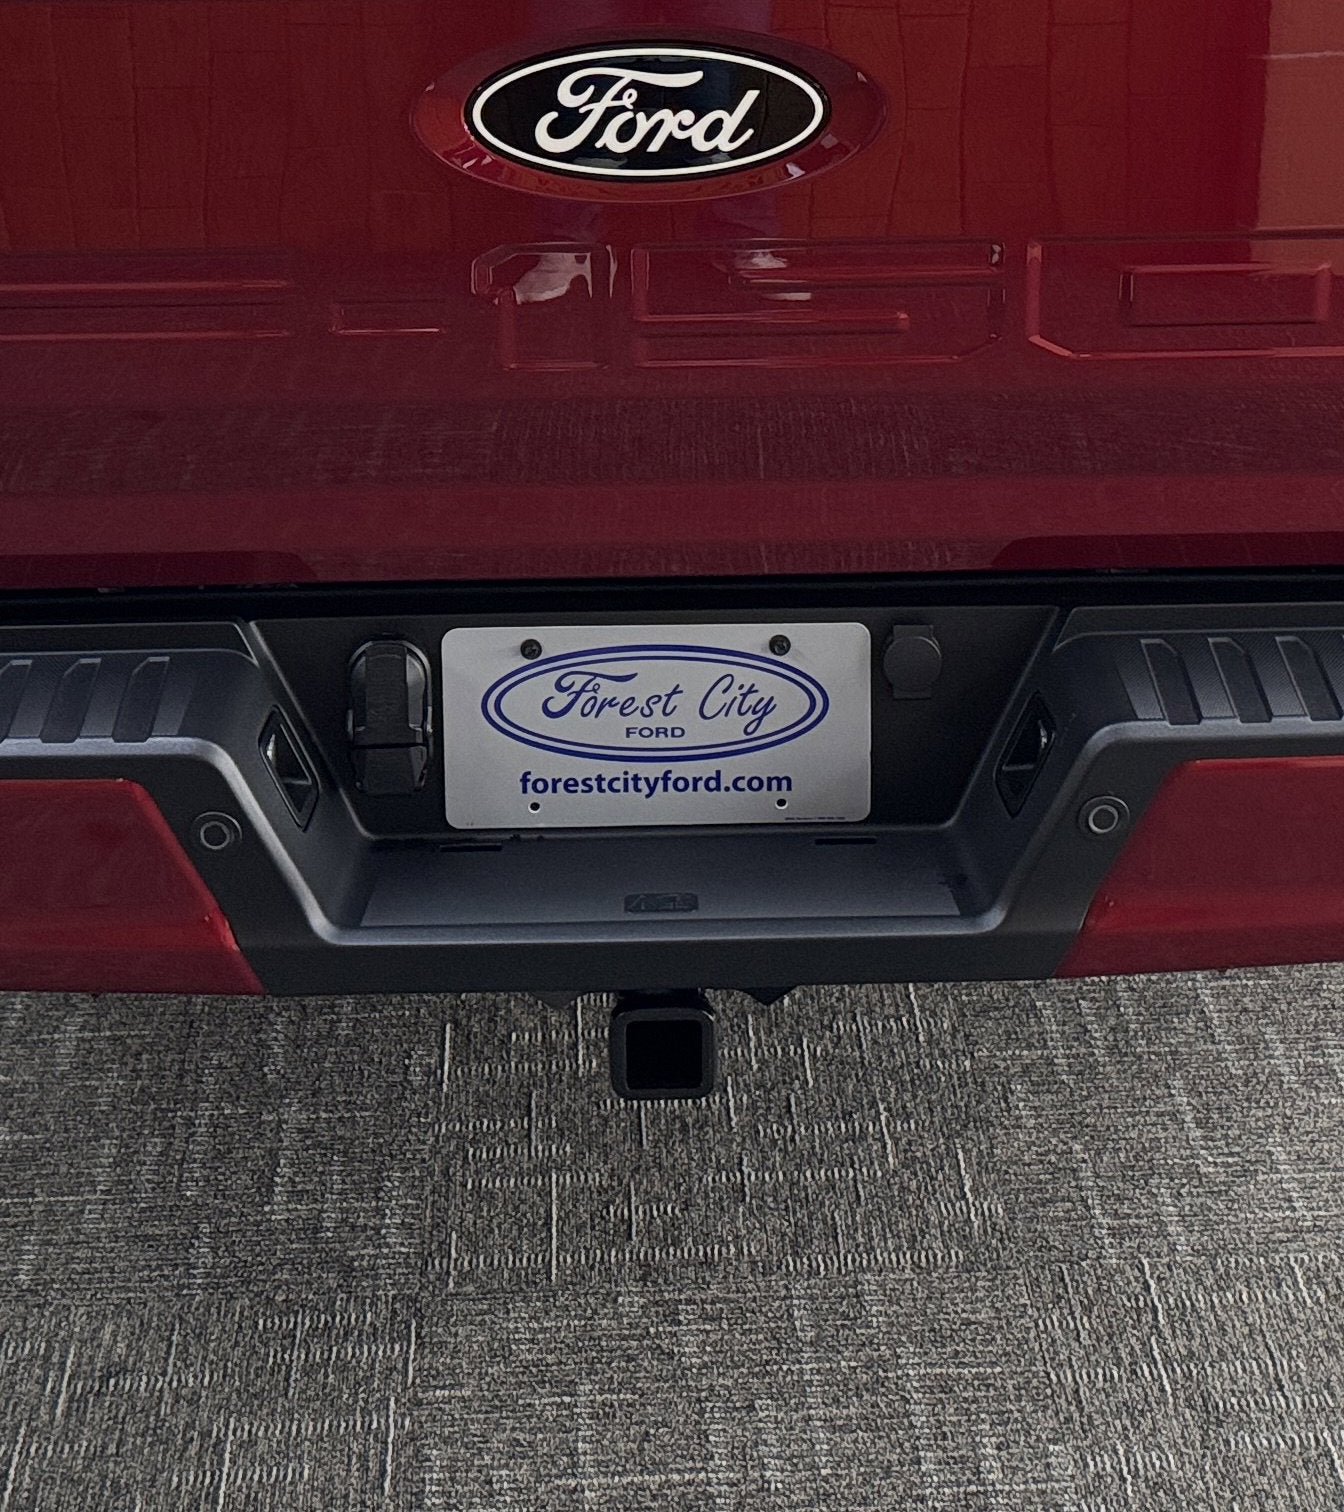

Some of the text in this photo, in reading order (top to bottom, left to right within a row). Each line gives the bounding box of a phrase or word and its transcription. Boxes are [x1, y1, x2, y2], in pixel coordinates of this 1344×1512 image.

[534, 66, 761, 154] Ford
[541, 670, 777, 736] Forest City
[624, 725, 686, 739] FORD
[519, 769, 793, 799] forestcityford.com
